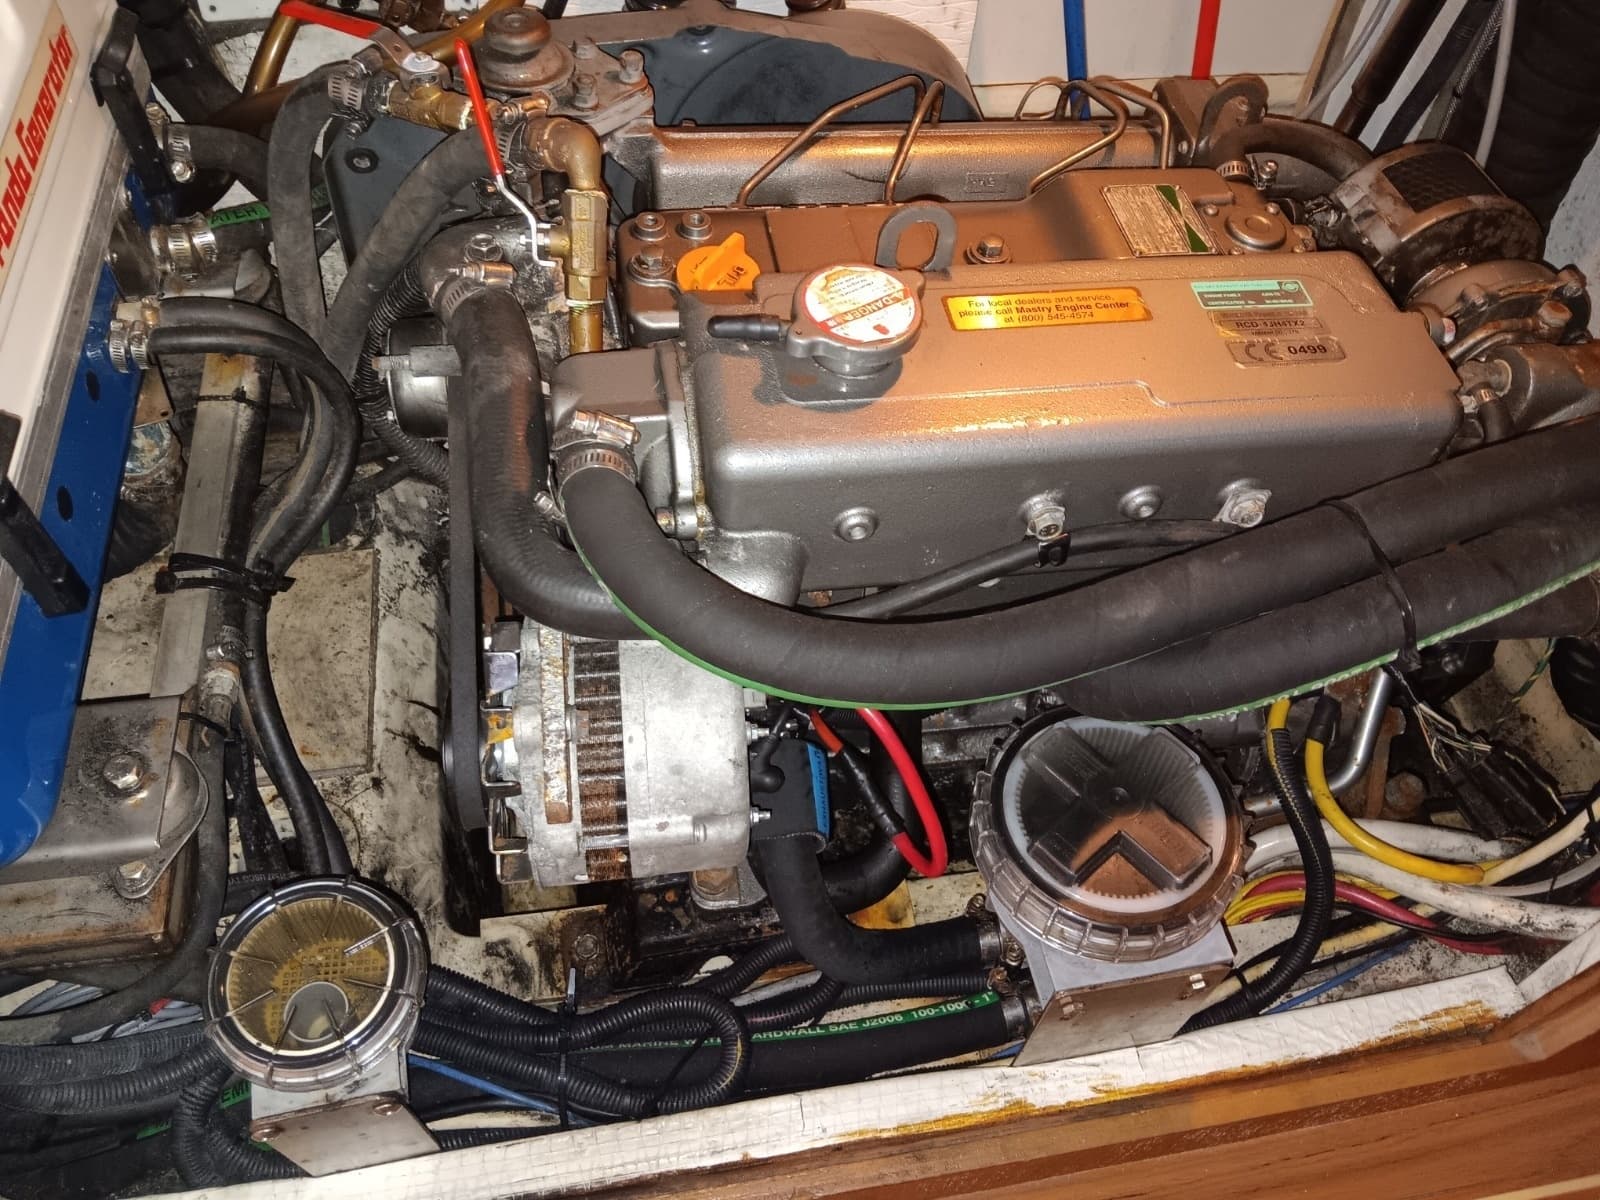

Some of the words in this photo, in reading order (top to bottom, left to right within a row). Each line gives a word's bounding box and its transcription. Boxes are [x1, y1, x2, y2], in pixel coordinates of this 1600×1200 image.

[15, 24, 73, 172] Generator
[0, 154, 33, 268] anda
[841, 296, 893, 321] DANGER
[958, 309, 992, 318] please
[995, 307, 1013, 315] call
[1015, 304, 1052, 315] Mastry
[1055, 303, 1093, 313] Engine
[1094, 301, 1130, 309] Center
[968, 300, 985, 308] For
[988, 299, 1012, 307] local
[1014, 297, 1051, 305] dealers
[1055, 295, 1073, 303] and
[1017, 314, 1044, 323] (800)
[1047, 312, 1094, 321] 545-4574
[1287, 343, 1328, 355] 0499
[751, 1025, 826, 1040] ARDWALL
[829, 1021, 858, 1032] SAE
[862, 1014, 904, 1027] J2006
